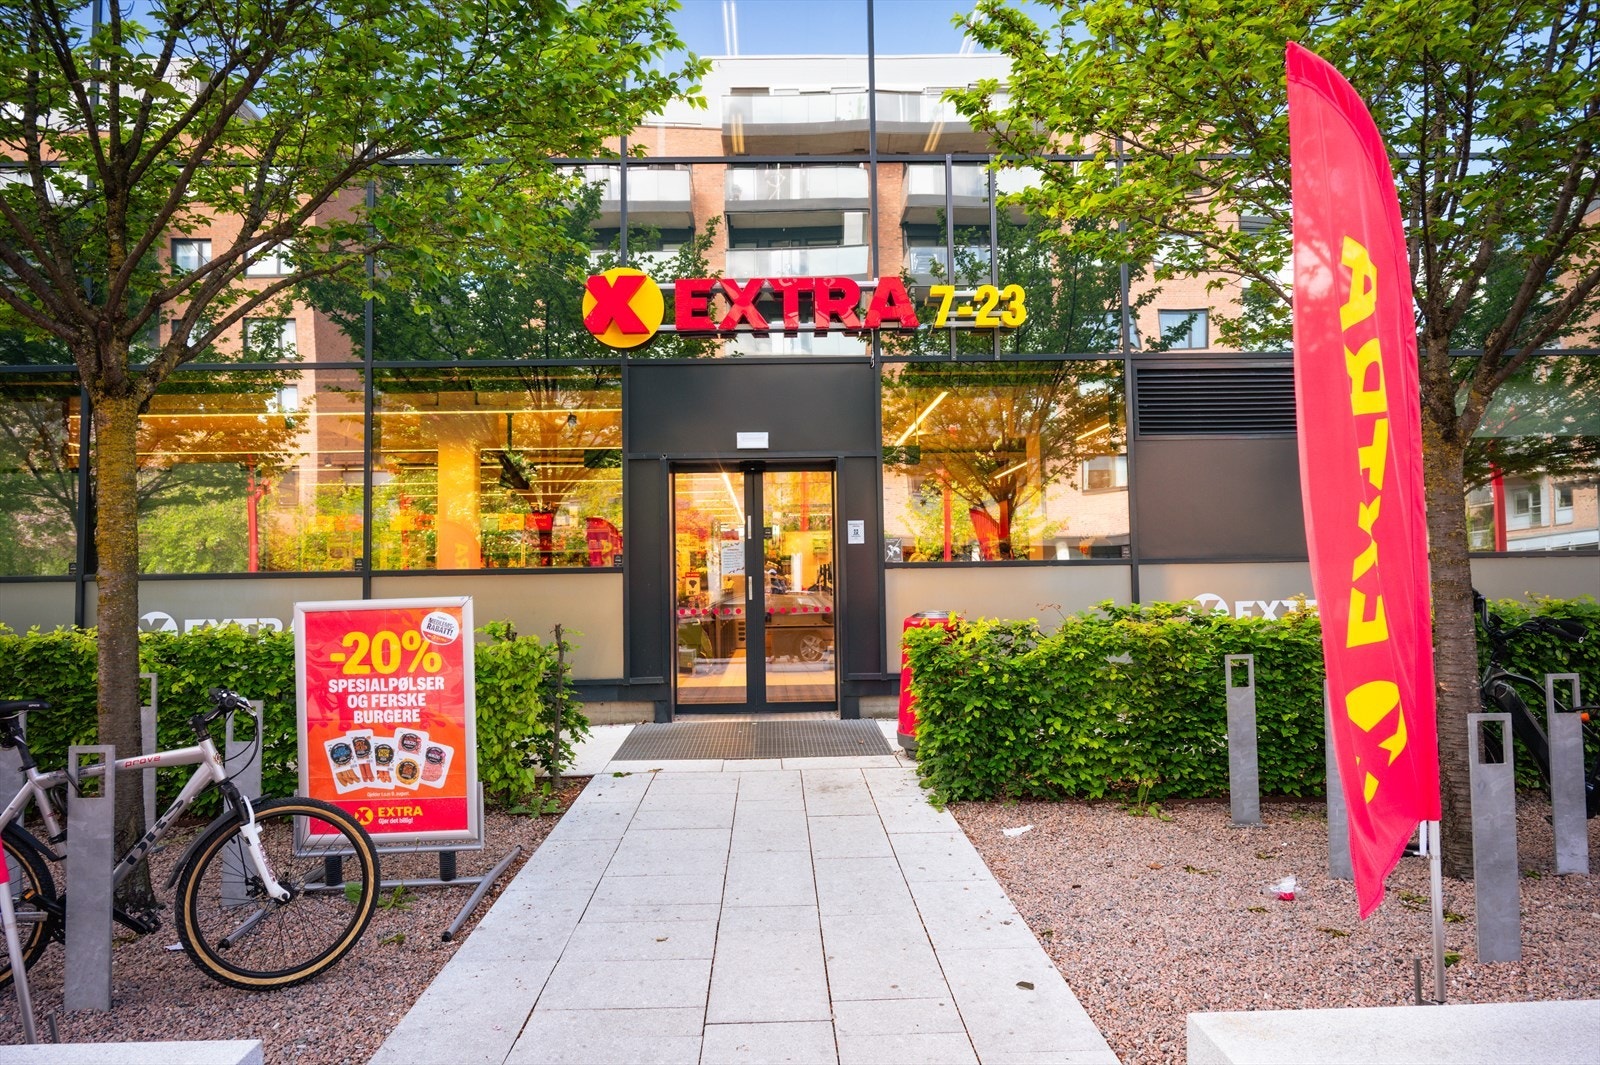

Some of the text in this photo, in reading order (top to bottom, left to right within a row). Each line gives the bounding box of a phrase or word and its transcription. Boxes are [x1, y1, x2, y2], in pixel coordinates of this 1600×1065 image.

[675, 276, 920, 331] EXTRA
[928, 284, 1027, 329] 7-23
[1235, 599, 1319, 621] EXT
[426, 623, 454, 636] RABATT!
[330, 629, 442, 675] -20%
[328, 676, 445, 693] SPESIALPØLSER
[347, 693, 427, 708] OG FERSKE
[353, 708, 421, 724] BURGERE
[377, 806, 424, 817] EXTRA
